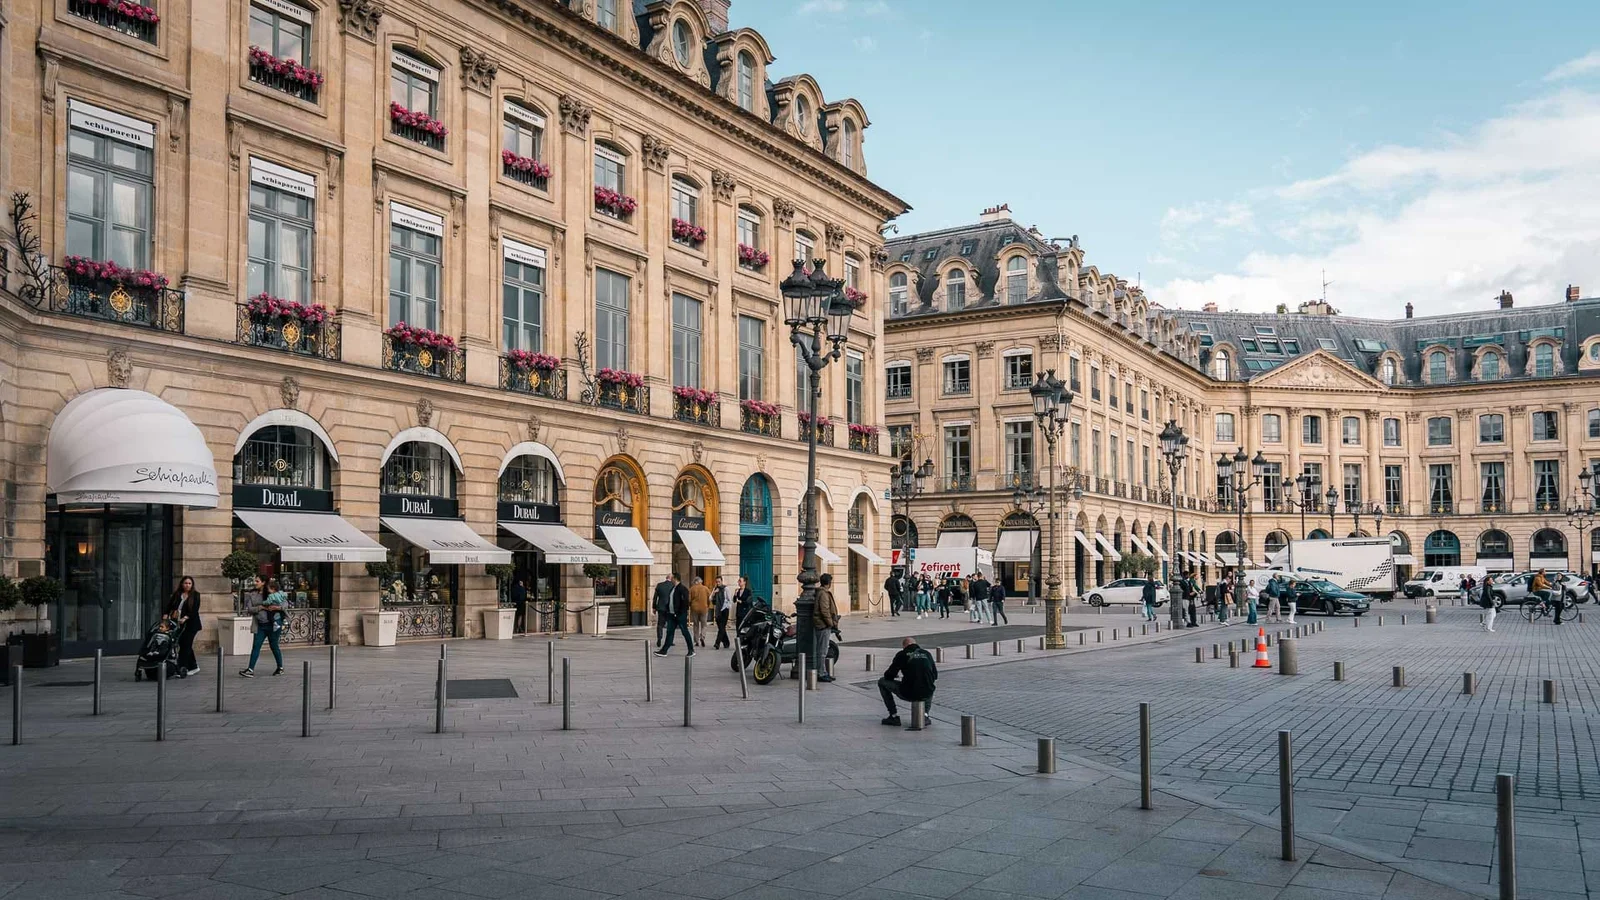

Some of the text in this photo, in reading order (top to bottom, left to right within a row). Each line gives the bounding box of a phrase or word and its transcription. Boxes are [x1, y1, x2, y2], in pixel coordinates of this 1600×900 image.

[84, 120, 141, 141] schiaparelli
[262, 175, 306, 193] schiaparelli
[602, 513, 626, 525] Cartier
[678, 518, 700, 530] Cartier
[920, 562, 961, 572] Zefirent
